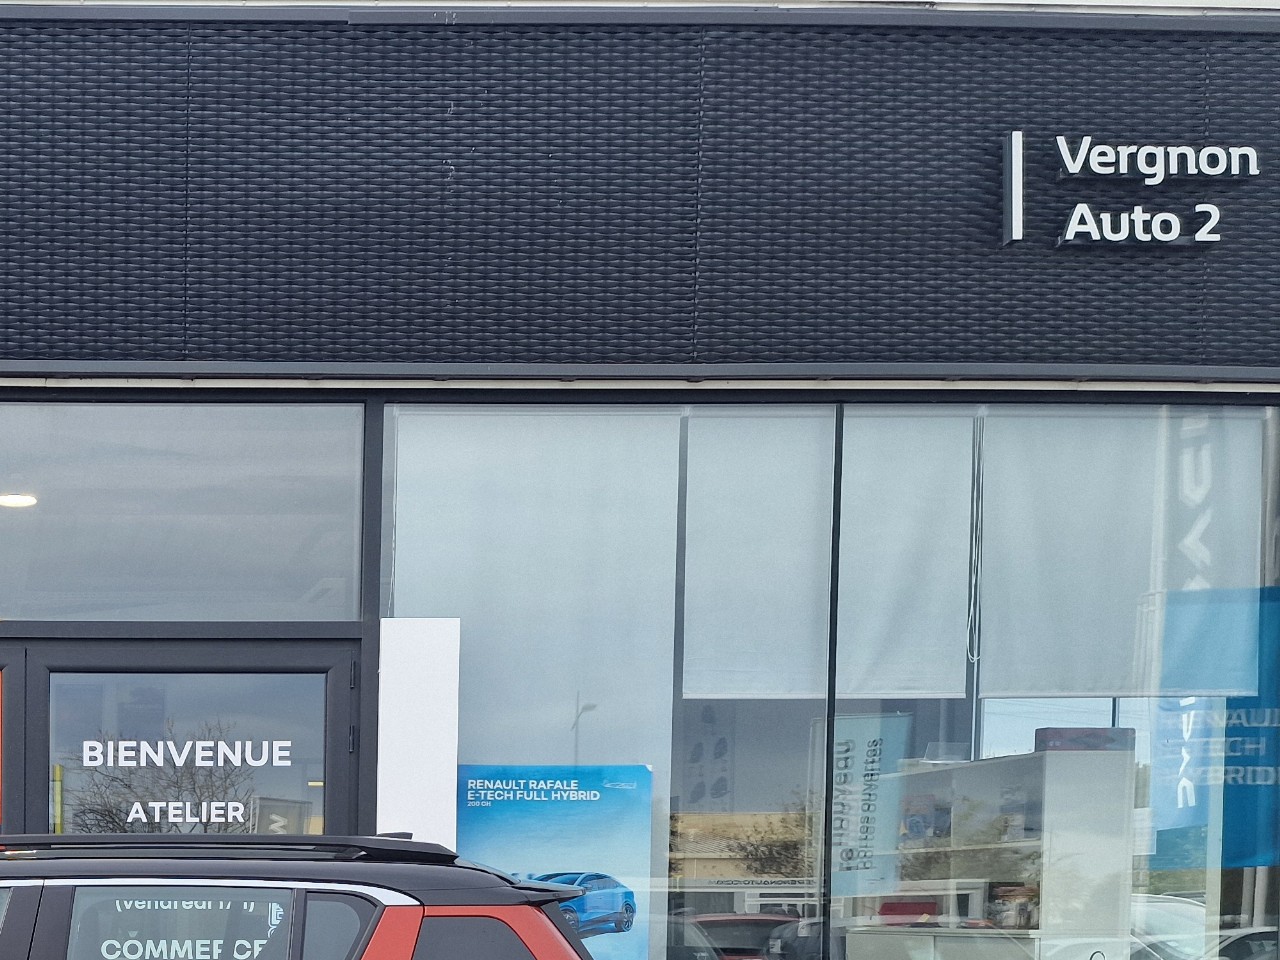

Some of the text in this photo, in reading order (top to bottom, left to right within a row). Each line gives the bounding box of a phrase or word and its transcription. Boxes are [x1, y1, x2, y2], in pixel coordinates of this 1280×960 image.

[1056, 135, 1260, 186] Vergnon
[1064, 203, 1221, 242] Auto 2
[82, 740, 292, 767] BIENVENUE
[467, 779, 579, 790] RENAULT RAFALE
[467, 790, 600, 801] E-TECH FULL HYBRID
[126, 801, 245, 823] ATELIER
